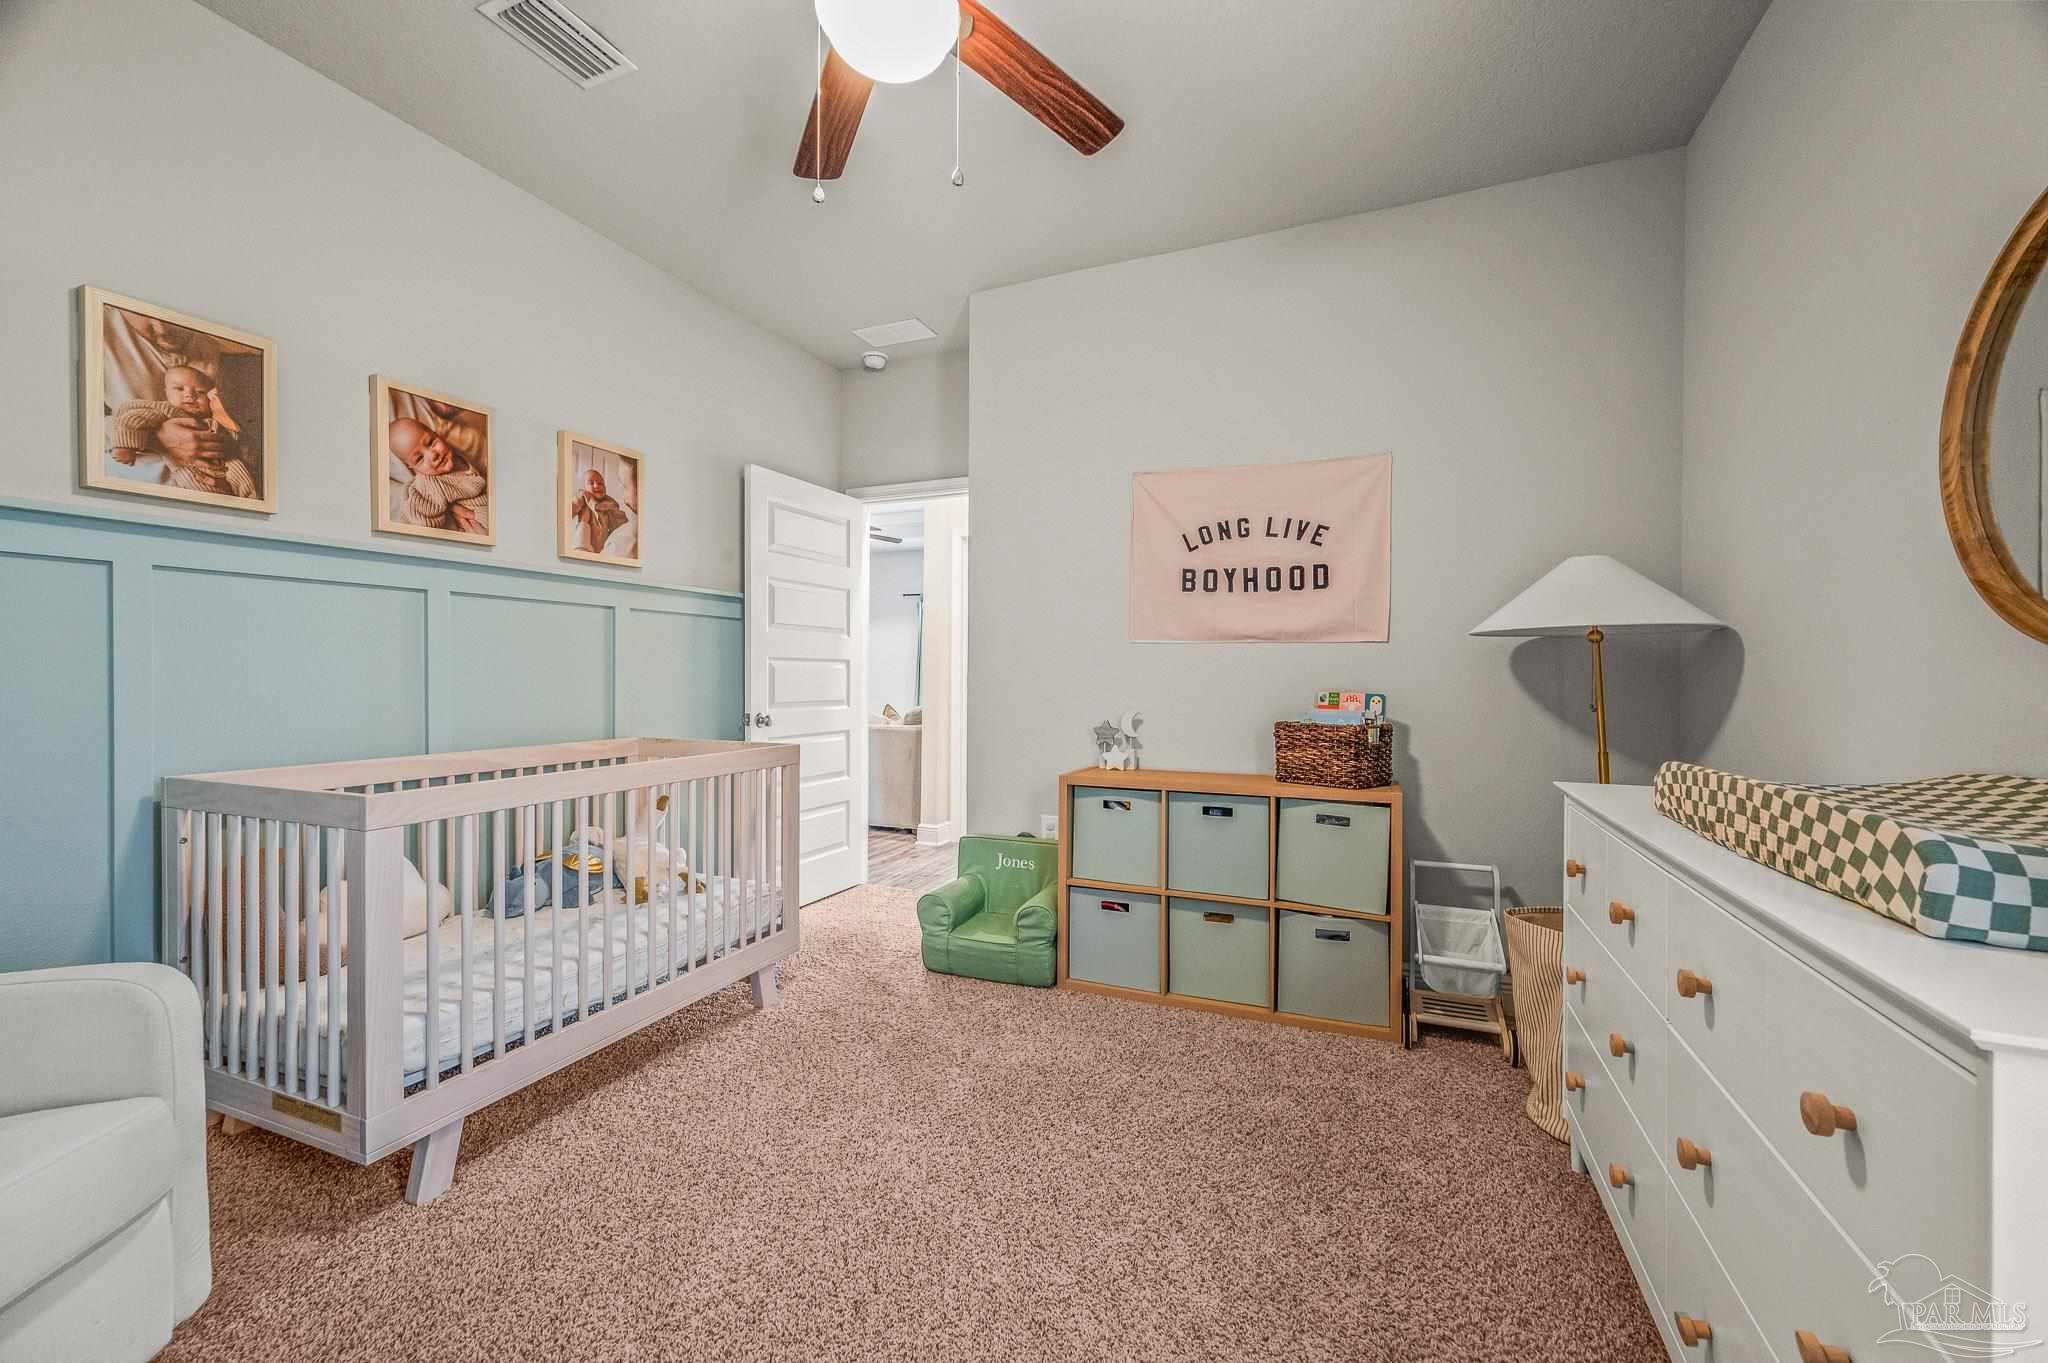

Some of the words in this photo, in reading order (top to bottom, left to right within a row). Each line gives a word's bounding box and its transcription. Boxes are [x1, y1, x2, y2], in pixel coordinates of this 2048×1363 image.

[1182, 517, 1250, 553] LONG
[1265, 517, 1330, 547] LIVE
[1181, 563, 1329, 593] BOYHOOD
[995, 852, 1036, 871] Jones
